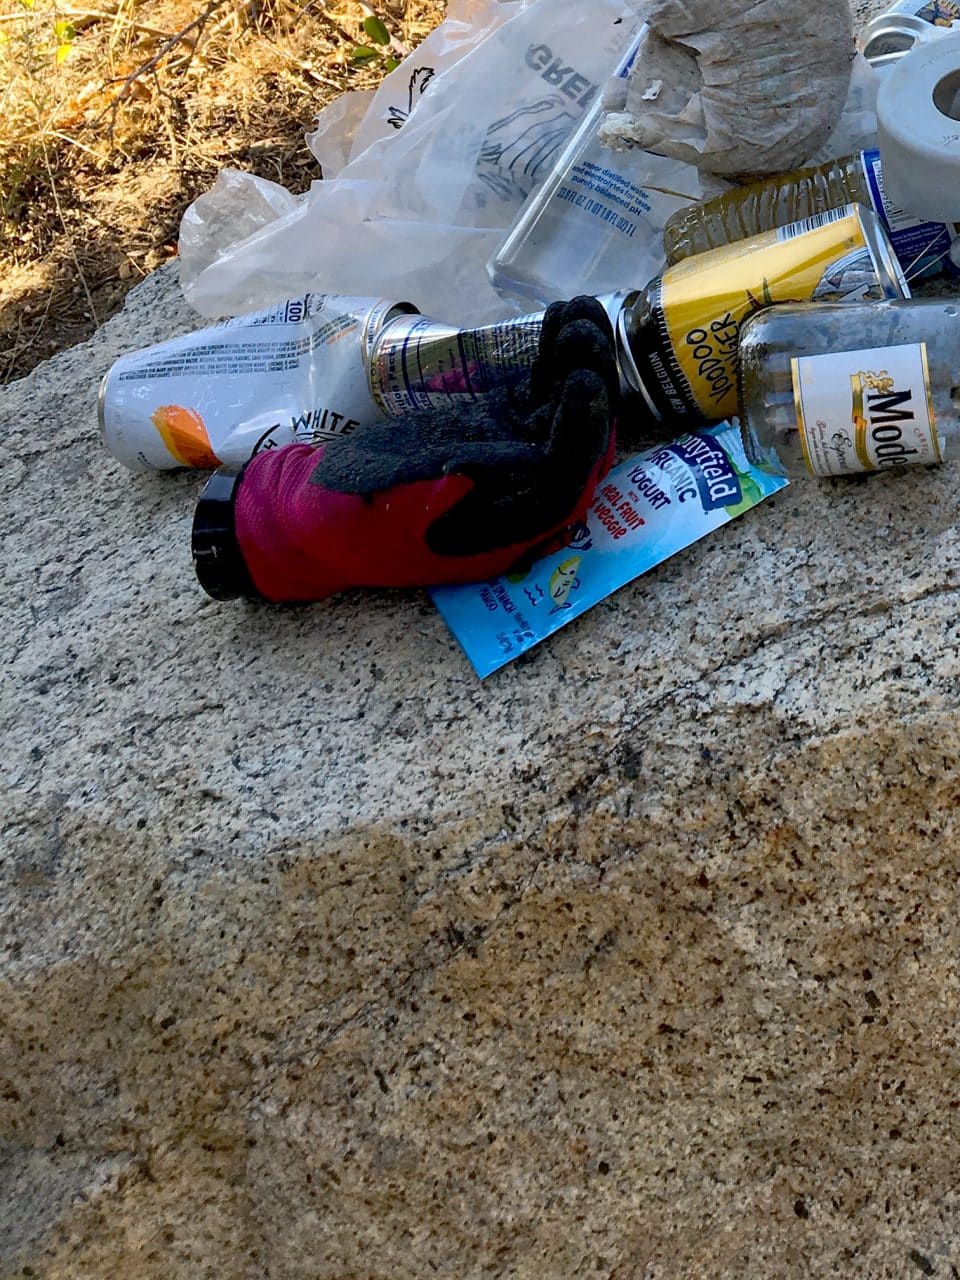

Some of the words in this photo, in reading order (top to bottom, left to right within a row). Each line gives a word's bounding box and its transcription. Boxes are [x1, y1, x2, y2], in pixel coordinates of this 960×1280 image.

[602, 169, 631, 187] distilled
[629, 184, 649, 200] water
[628, 205, 642, 217] pH
[288, 300, 303, 322] 100
[709, 313, 740, 370] NGER
[648, 351, 677, 396] BELGIUM
[686, 329, 735, 404] VOODOO
[290, 408, 361, 435] WHITE
[866, 388, 918, 466] Mode
[626, 465, 672, 511] YOGURT
[674, 434, 738, 501] onyfield
[616, 500, 646, 531] FRUIT
